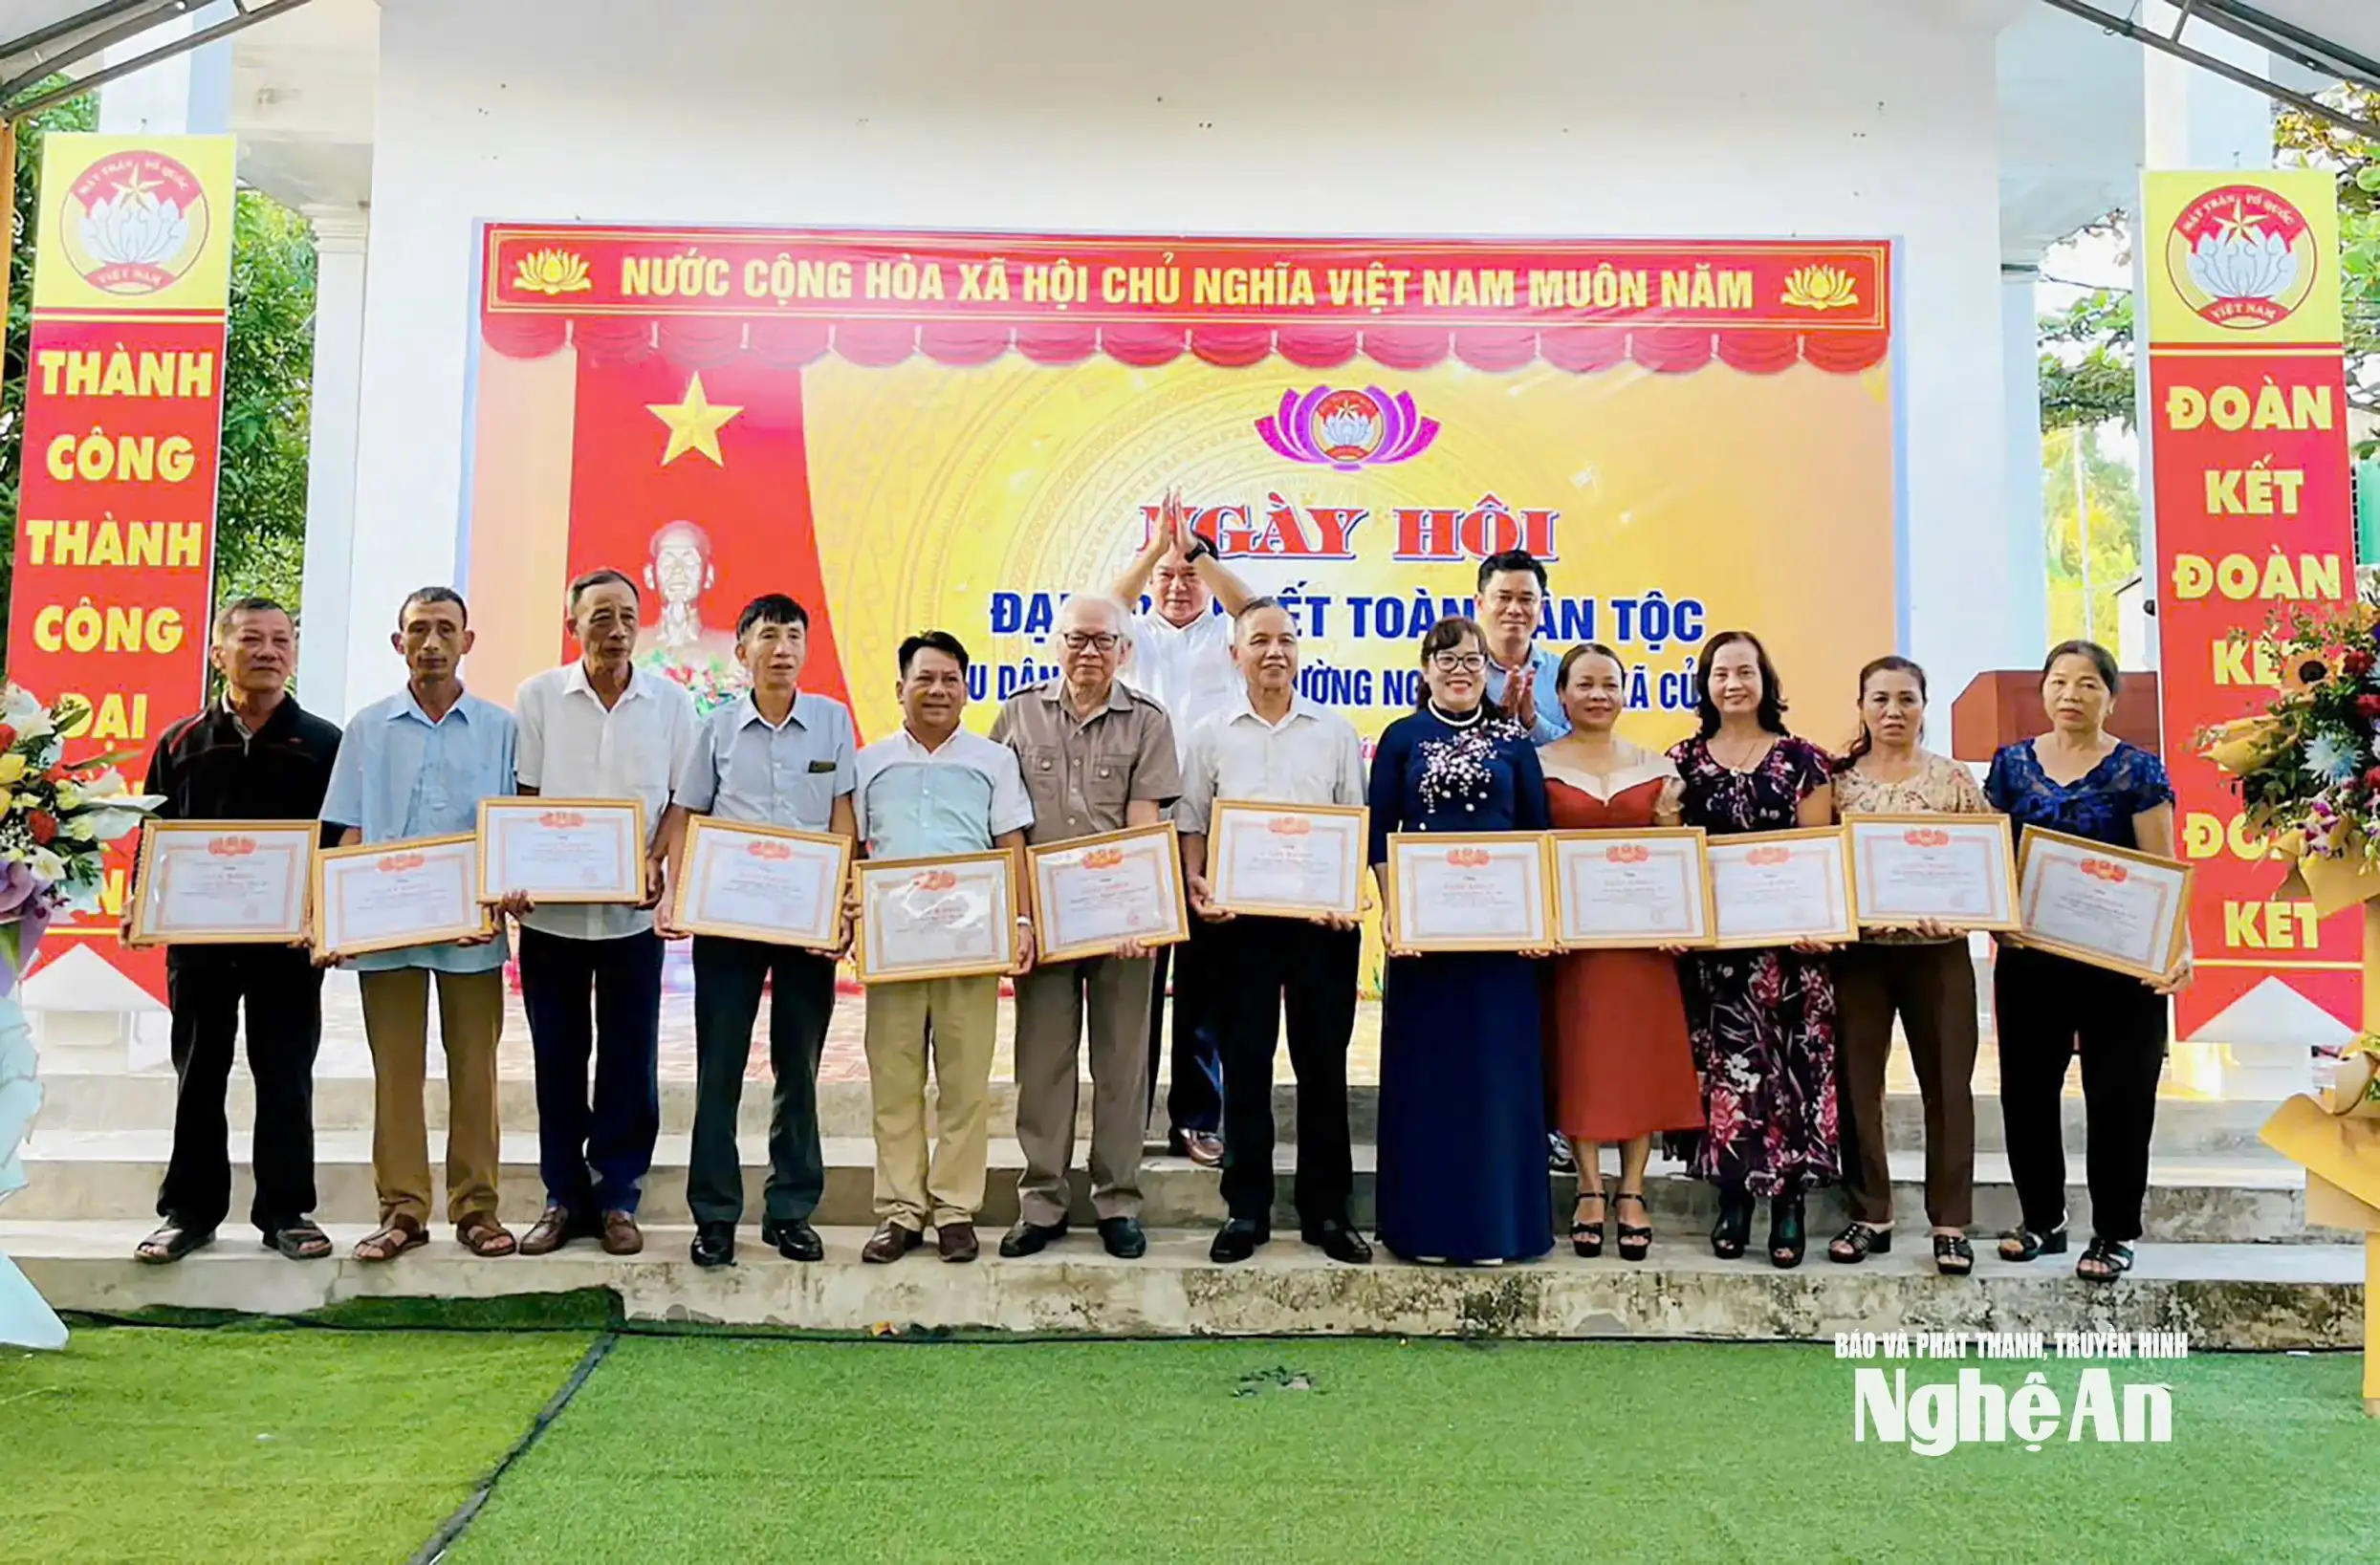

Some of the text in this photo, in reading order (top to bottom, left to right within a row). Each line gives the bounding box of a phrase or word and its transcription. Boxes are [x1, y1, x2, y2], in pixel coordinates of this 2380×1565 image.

[622, 245, 1753, 314] NƯỚC CỘNG HÒA XÃ HỘI CHỦ NGHĨA VIỆT NAM MUÔN NĂM
[37, 341, 213, 397] THÀNH
[2165, 375, 2333, 431] ĐOÀN
[46, 425, 196, 483] CÔNG
[2205, 453, 2304, 515] KẾT
[26, 511, 203, 566] THÀNH
[2172, 545, 2342, 600] ĐOÀN
[33, 596, 184, 654] CÔNG
[990, 592, 1070, 644] ĐẠ
[1610, 590, 1704, 651] TỘC
